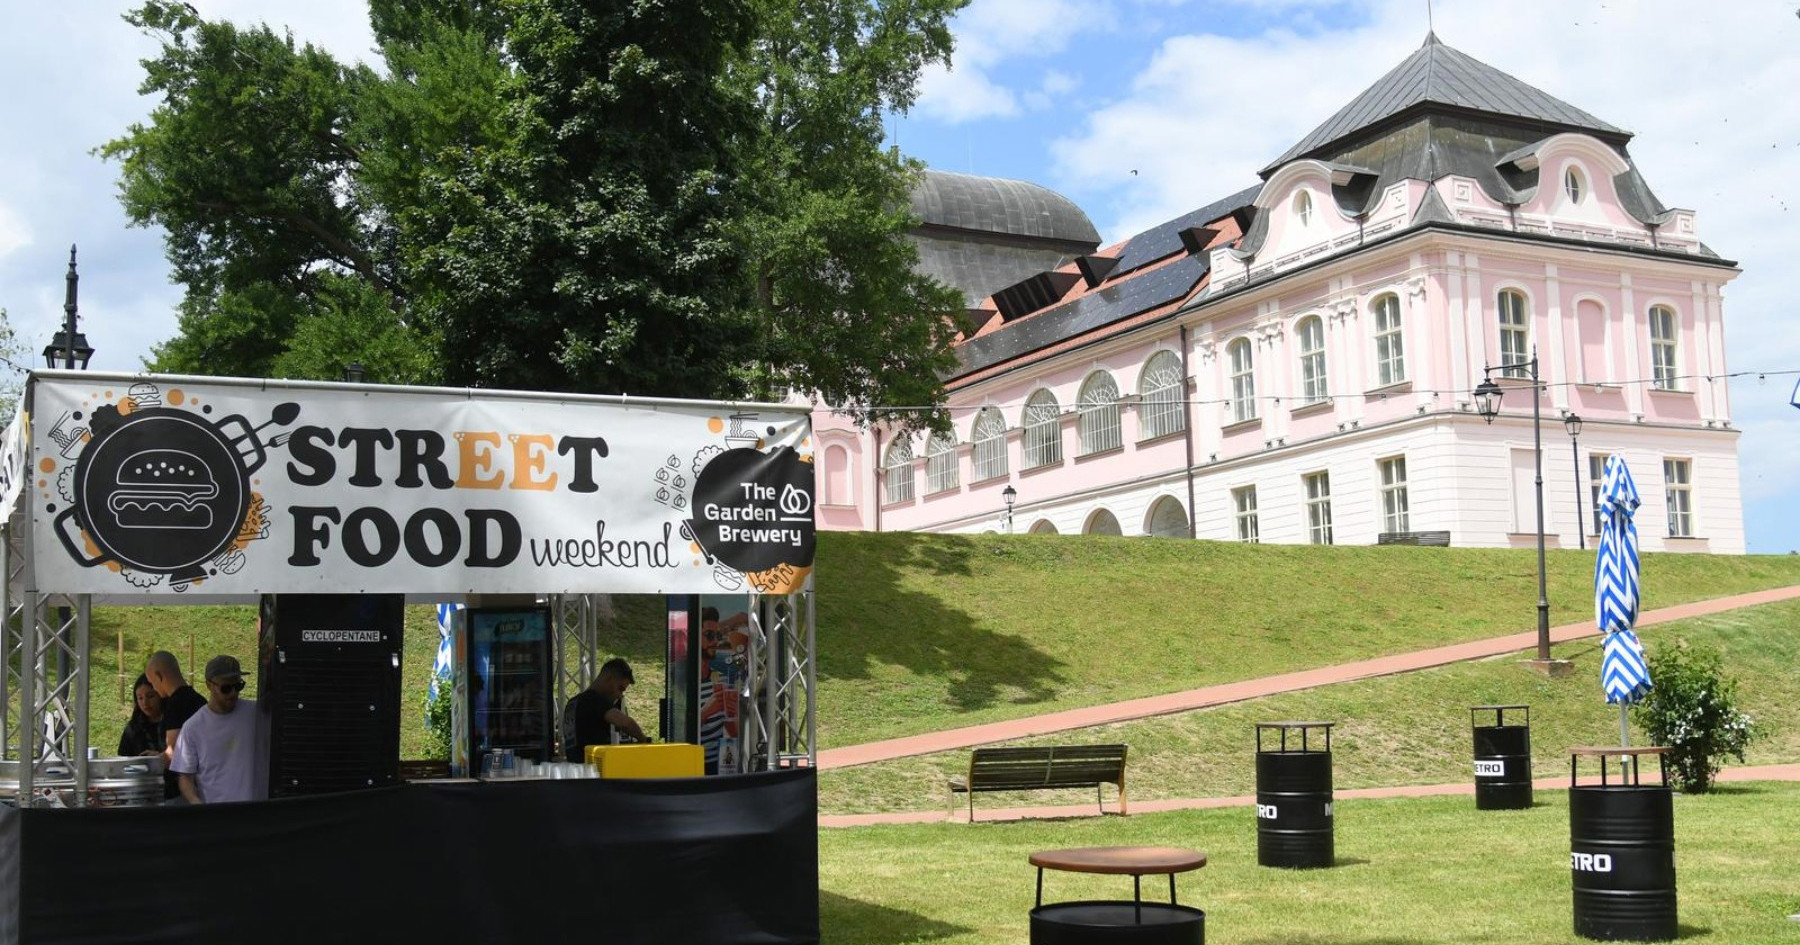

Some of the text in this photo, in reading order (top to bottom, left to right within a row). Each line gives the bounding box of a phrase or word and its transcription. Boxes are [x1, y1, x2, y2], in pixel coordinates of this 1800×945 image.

[286, 425, 609, 493] STREET
[740, 482, 776, 500] The
[704, 503, 776, 521] Garden
[287, 506, 680, 568] FOOD weekend
[719, 524, 801, 546] Brewery
[303, 631, 379, 640] CYCLOPENTANE
